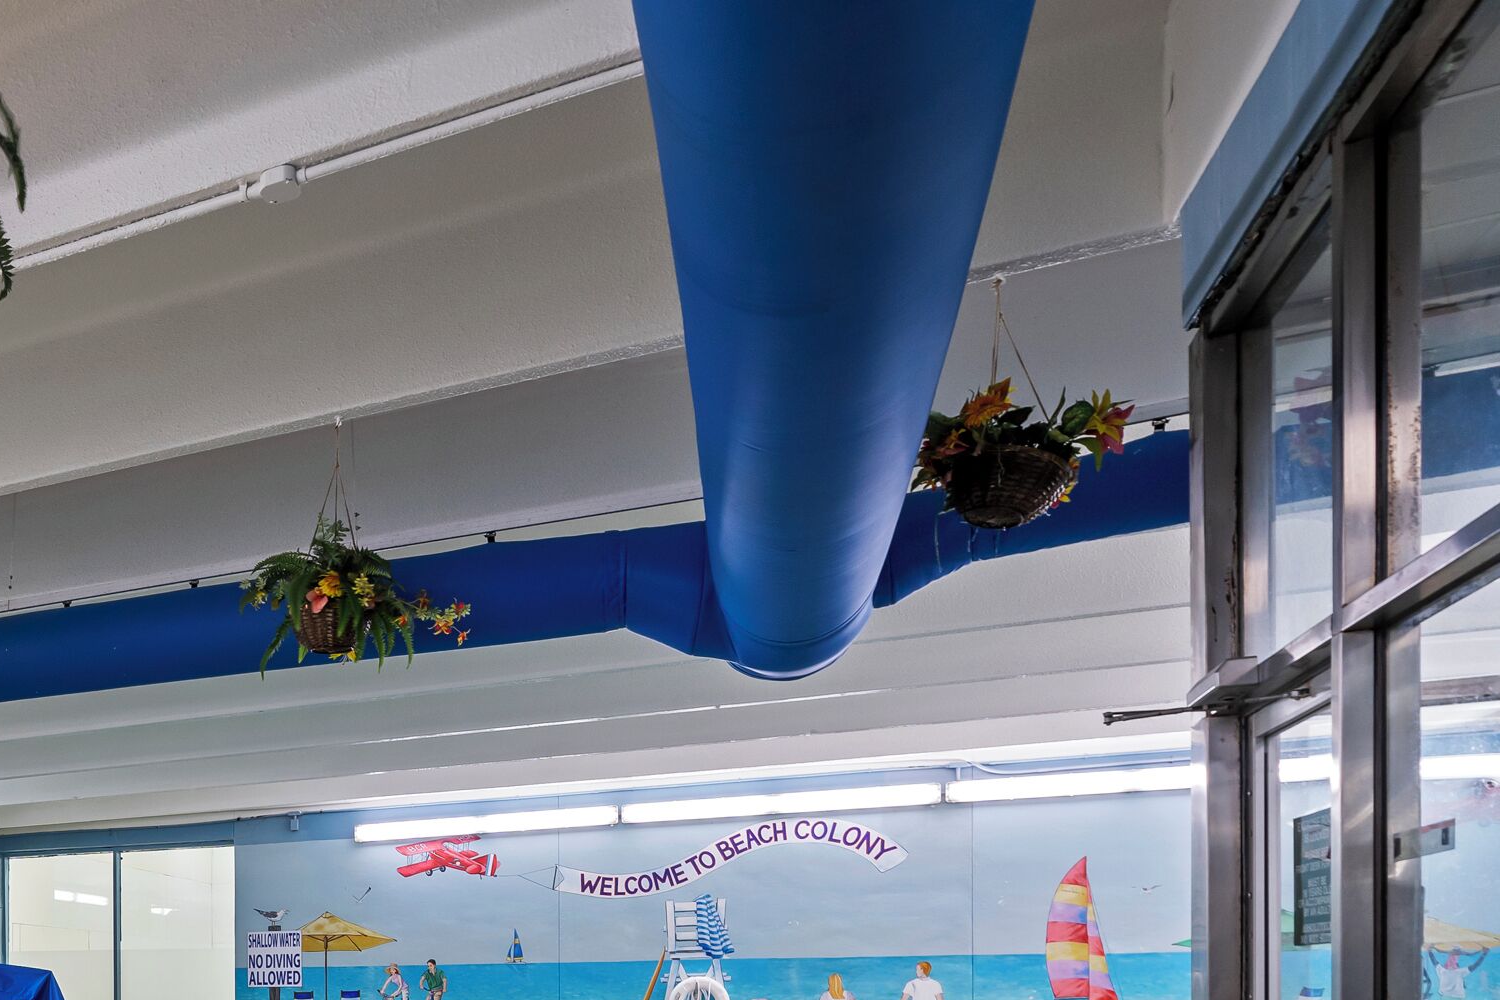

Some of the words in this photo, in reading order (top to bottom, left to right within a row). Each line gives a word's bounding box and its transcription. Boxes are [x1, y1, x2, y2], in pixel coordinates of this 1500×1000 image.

[581, 863, 688, 896] WELCOME
[685, 850, 715, 875] TO
[715, 822, 787, 861] BEACH
[794, 820, 897, 860] COLONY
[249, 933, 278, 948] SHALLOW
[280, 933, 300, 947] WATER
[249, 954, 263, 968] NO
[266, 954, 300, 968] DIVING
[249, 971, 301, 985] ALLOWED
